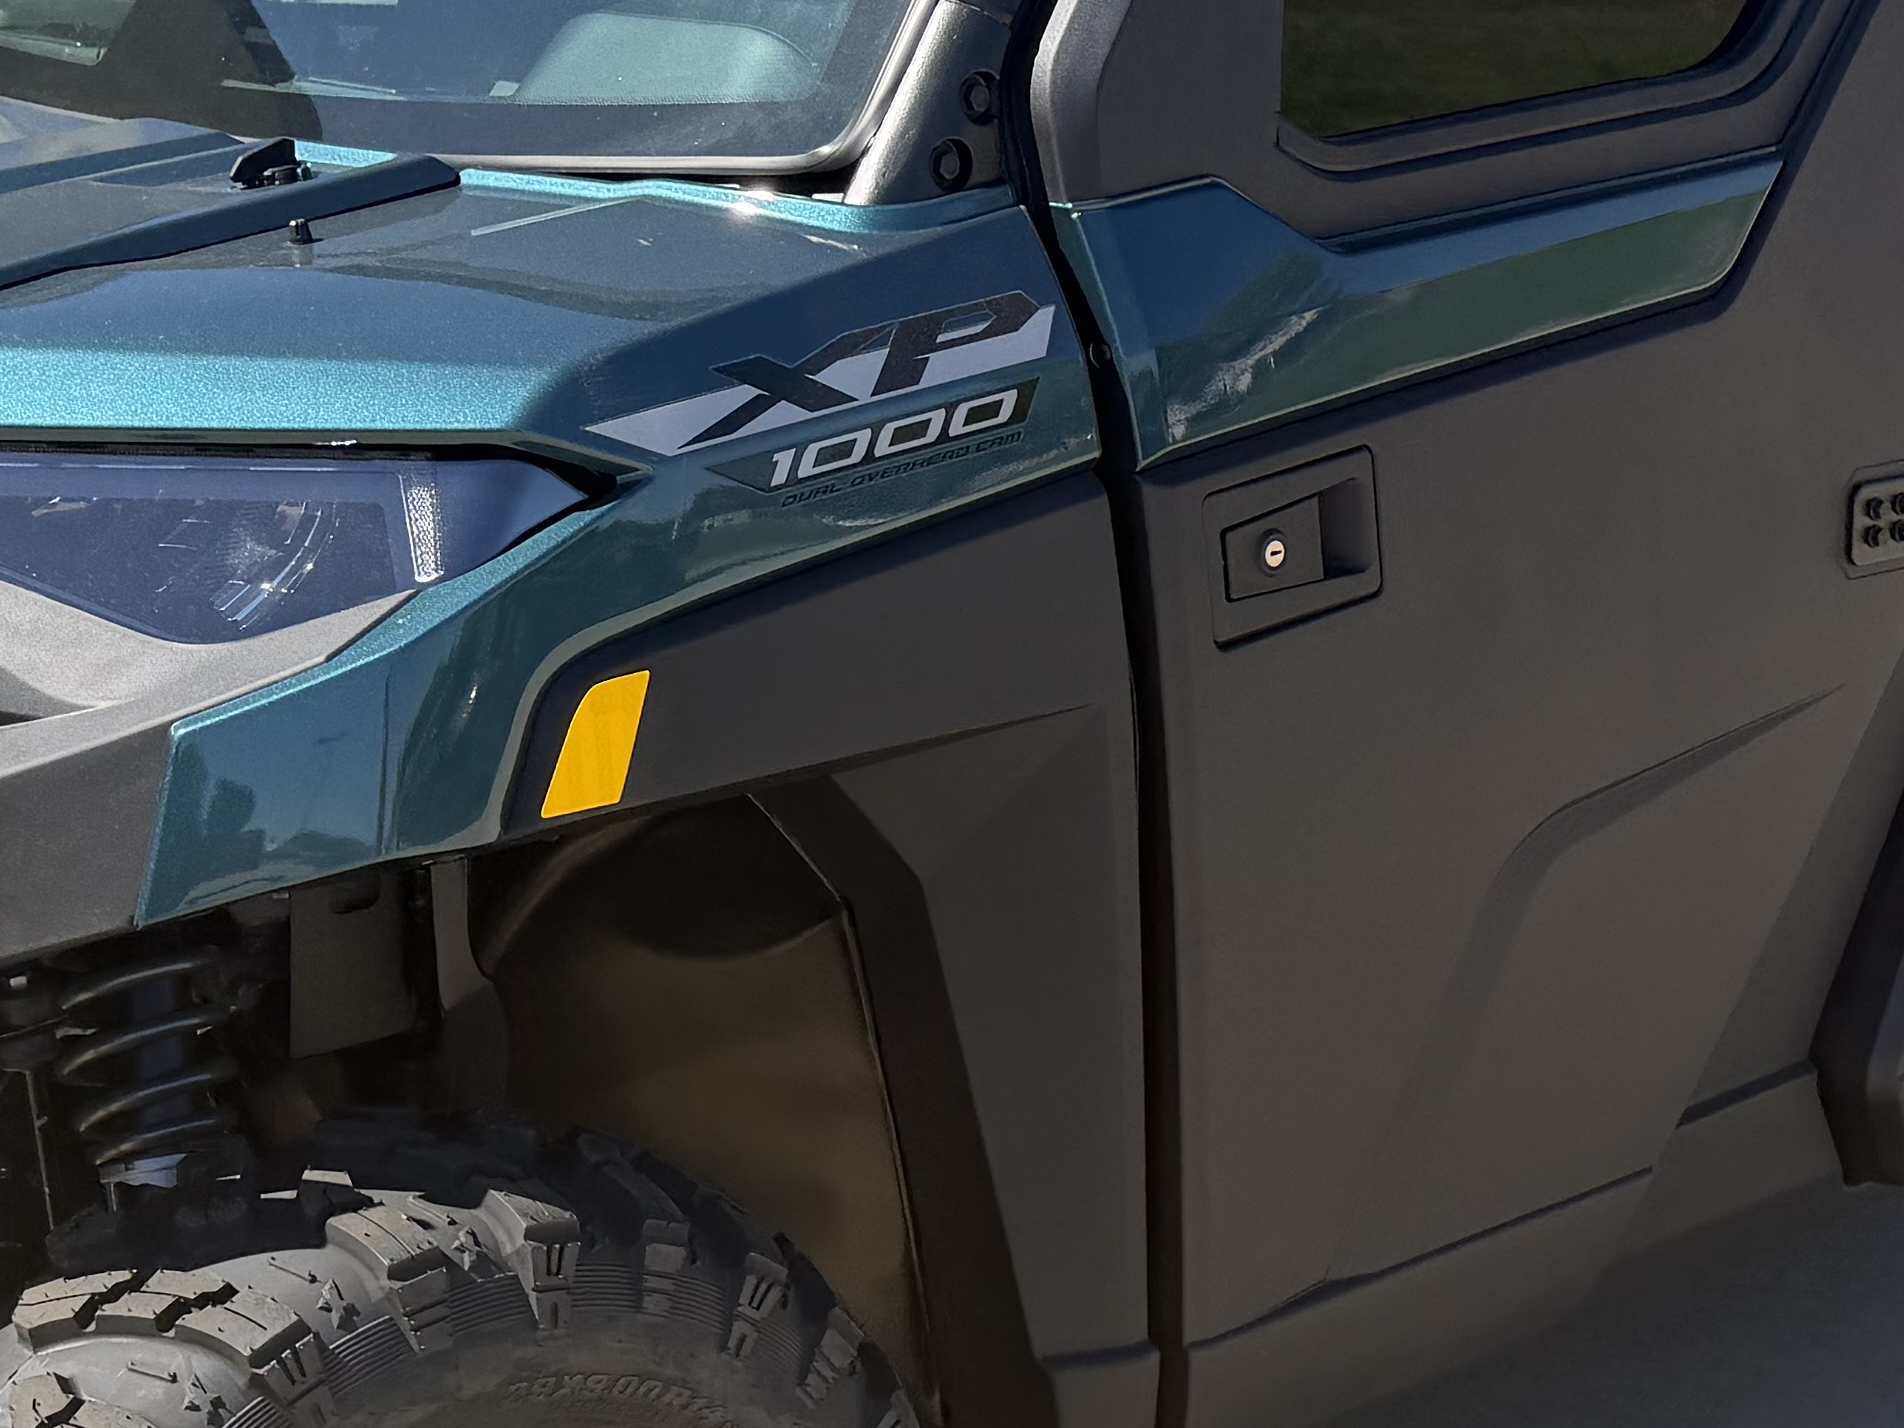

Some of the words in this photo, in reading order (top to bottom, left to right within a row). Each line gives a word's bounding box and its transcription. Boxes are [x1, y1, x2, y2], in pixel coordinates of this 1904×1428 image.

[676, 289, 1041, 450] XP
[770, 388, 1018, 488] 1000
[780, 482, 845, 509] DUAL
[850, 444, 971, 486] OVERHEAD
[973, 430, 1023, 453] CAM
